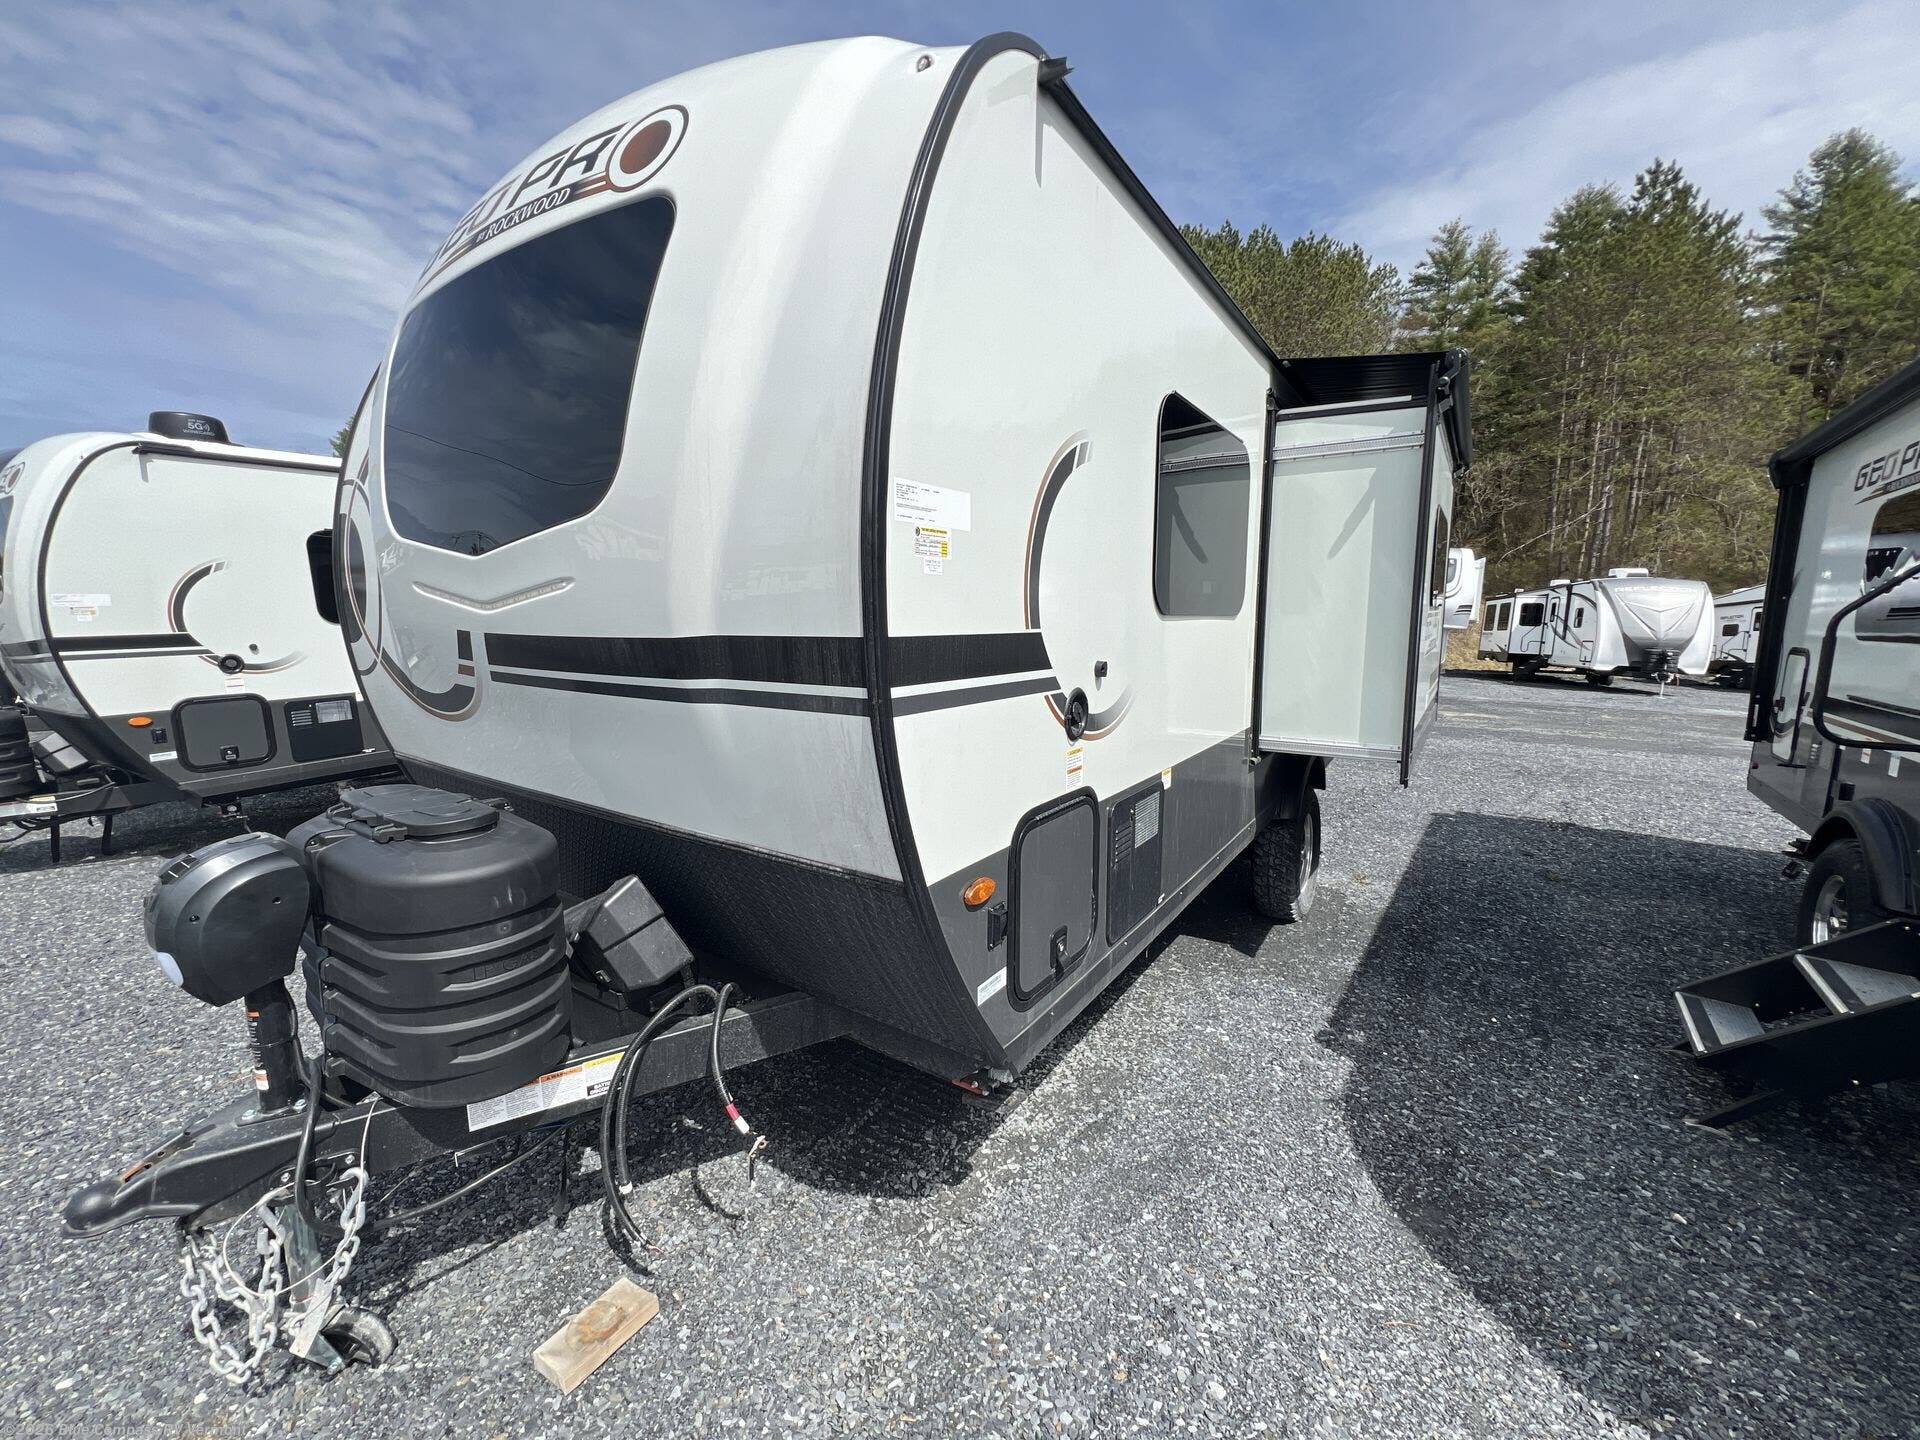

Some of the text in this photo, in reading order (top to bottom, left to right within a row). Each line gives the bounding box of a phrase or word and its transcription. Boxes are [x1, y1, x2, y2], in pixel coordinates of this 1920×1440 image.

[504, 104, 690, 211] PRO
[485, 187, 571, 240] ROCKWOOD
[187, 421, 204, 431] 5G
[1854, 449, 1902, 492] GEO
